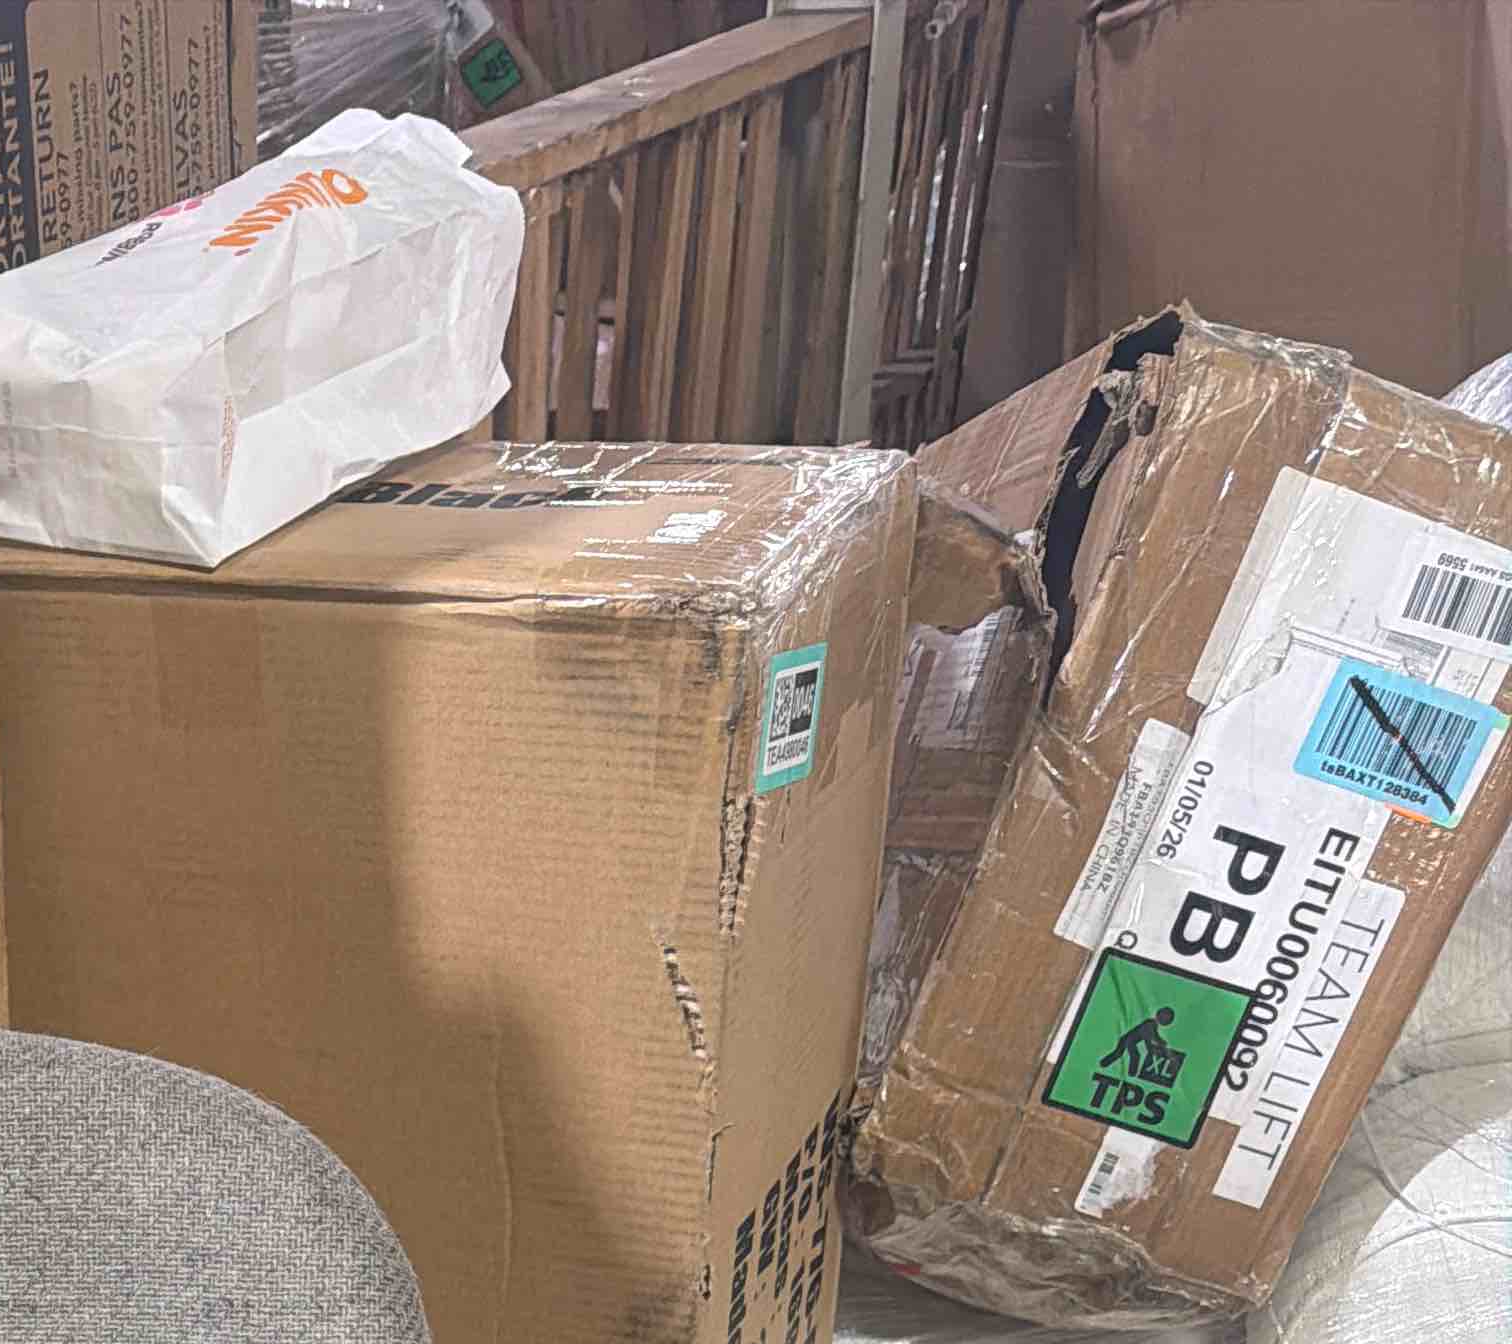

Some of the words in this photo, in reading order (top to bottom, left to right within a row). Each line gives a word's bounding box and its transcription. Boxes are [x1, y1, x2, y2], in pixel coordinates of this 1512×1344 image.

[33, 68, 60, 246] RETURN
[104, 71, 124, 154] PAS
[1156, 760, 1215, 860] 01/05/26
[1080, 843, 1110, 893] CHINA
[1169, 824, 1287, 964] PB
[1222, 827, 1362, 1093] EITU0060092
[1284, 917, 1386, 1059] TEAM
[1090, 1073, 1171, 1128] TPS
[1145, 1055, 1173, 1079] XL
[1237, 1070, 1311, 1172] LIFT
